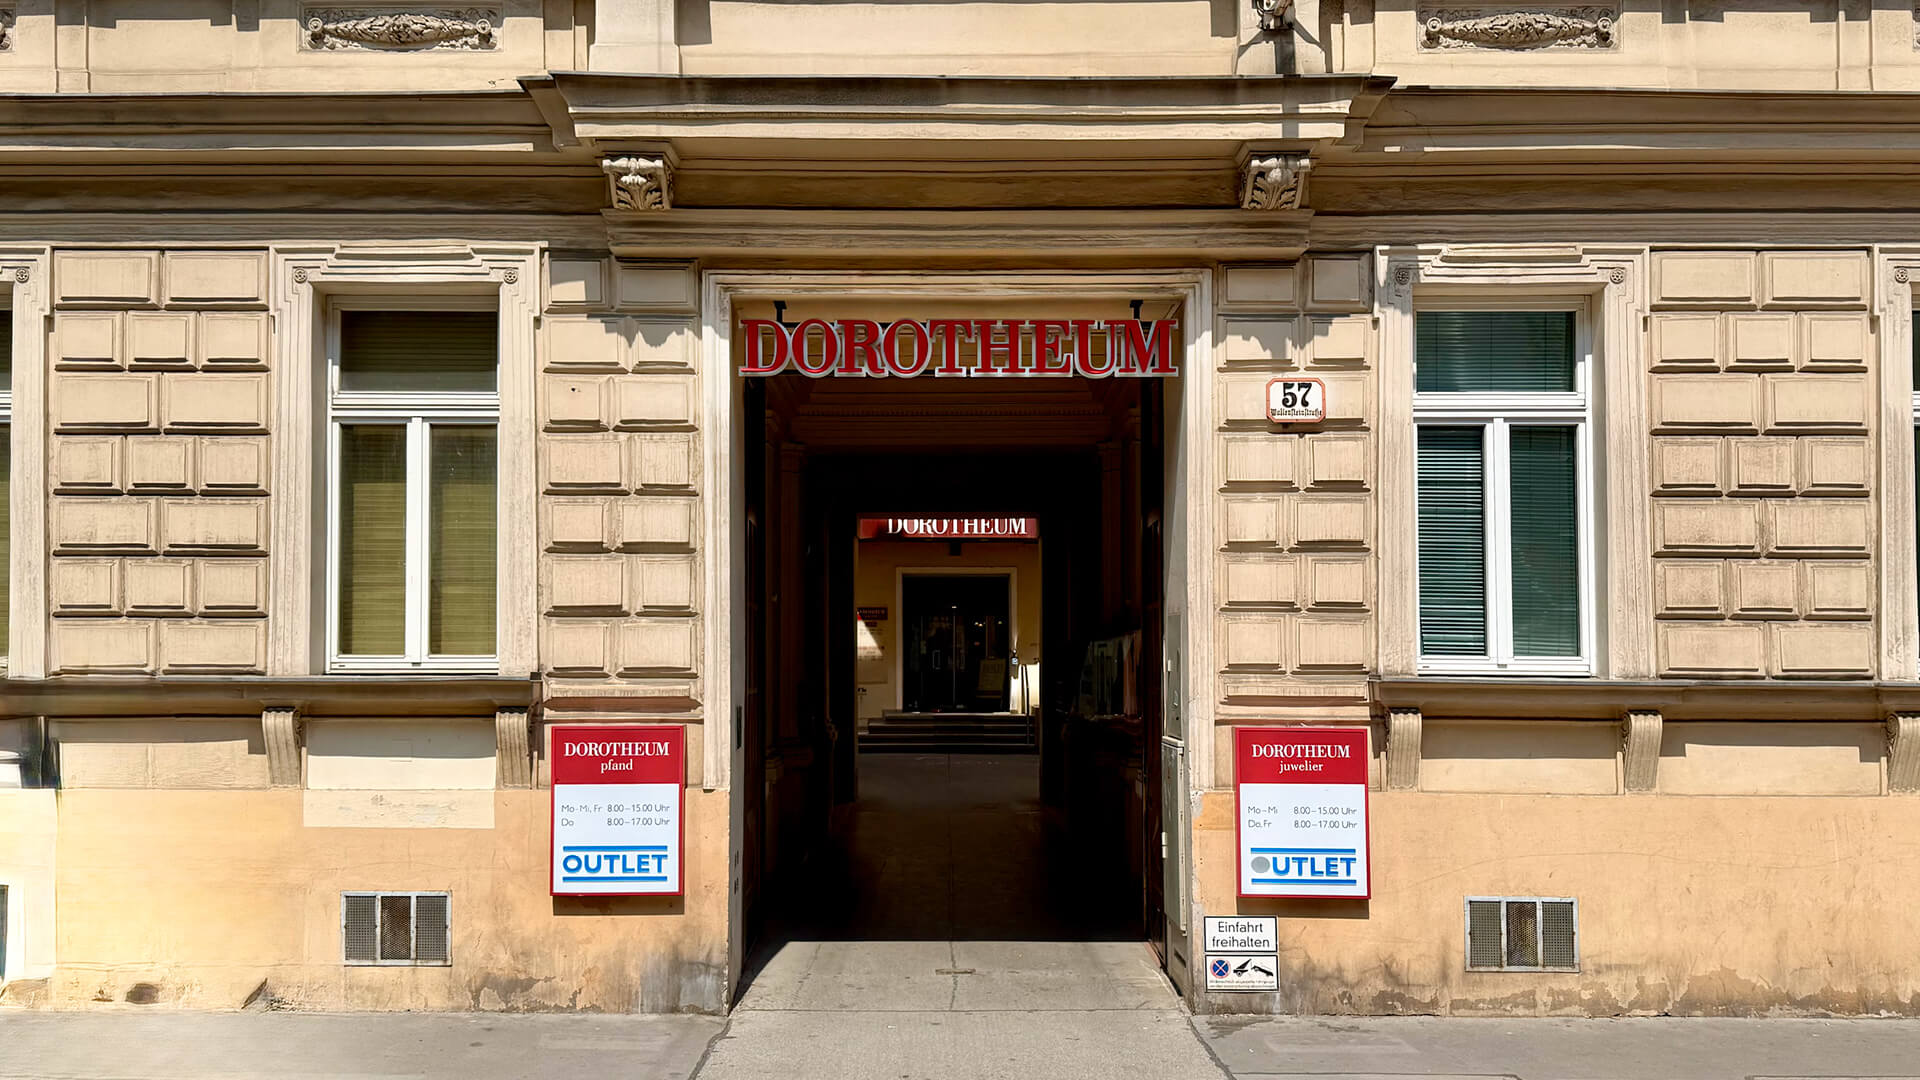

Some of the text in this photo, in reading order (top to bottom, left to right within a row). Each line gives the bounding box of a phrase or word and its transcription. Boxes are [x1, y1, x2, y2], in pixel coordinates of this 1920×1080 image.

[739, 318, 1179, 377] DOROTHEUM
[1281, 382, 1312, 408] 57
[887, 518, 1027, 535] DOROTHEUM
[564, 741, 670, 757] DOROTHEUM
[1251, 744, 1351, 758] DOROTHEUM
[600, 758, 633, 774] pfand
[1279, 760, 1324, 774] juwelier
[654, 803, 670, 812] Uhr
[1341, 806, 1358, 815] Uhr
[561, 818, 575, 827] Do
[654, 817, 670, 826] Uhr
[1341, 820, 1358, 829] Uhr
[562, 854, 669, 874] OUTLET
[1250, 856, 1357, 877] UTLET
[1217, 921, 1264, 933] Einfahrt
[1212, 935, 1270, 948] freihalten
